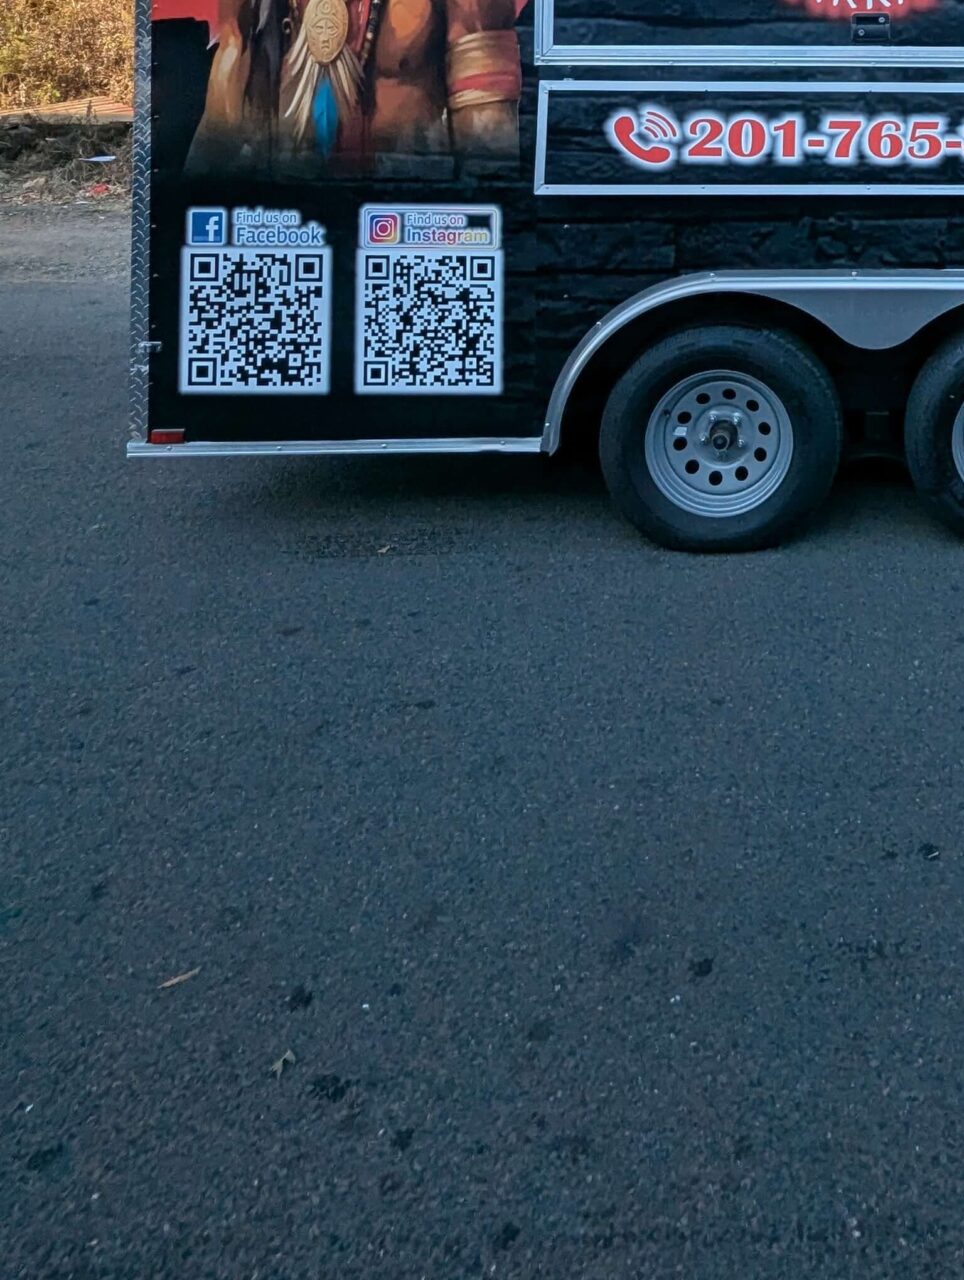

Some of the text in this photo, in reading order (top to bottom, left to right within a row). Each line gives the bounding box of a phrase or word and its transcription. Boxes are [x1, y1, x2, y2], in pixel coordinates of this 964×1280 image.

[236, 211, 297, 223] Find us on
[407, 213, 464, 225] Find us on
[236, 226, 322, 244] Facebook
[407, 228, 488, 245] Instagram
